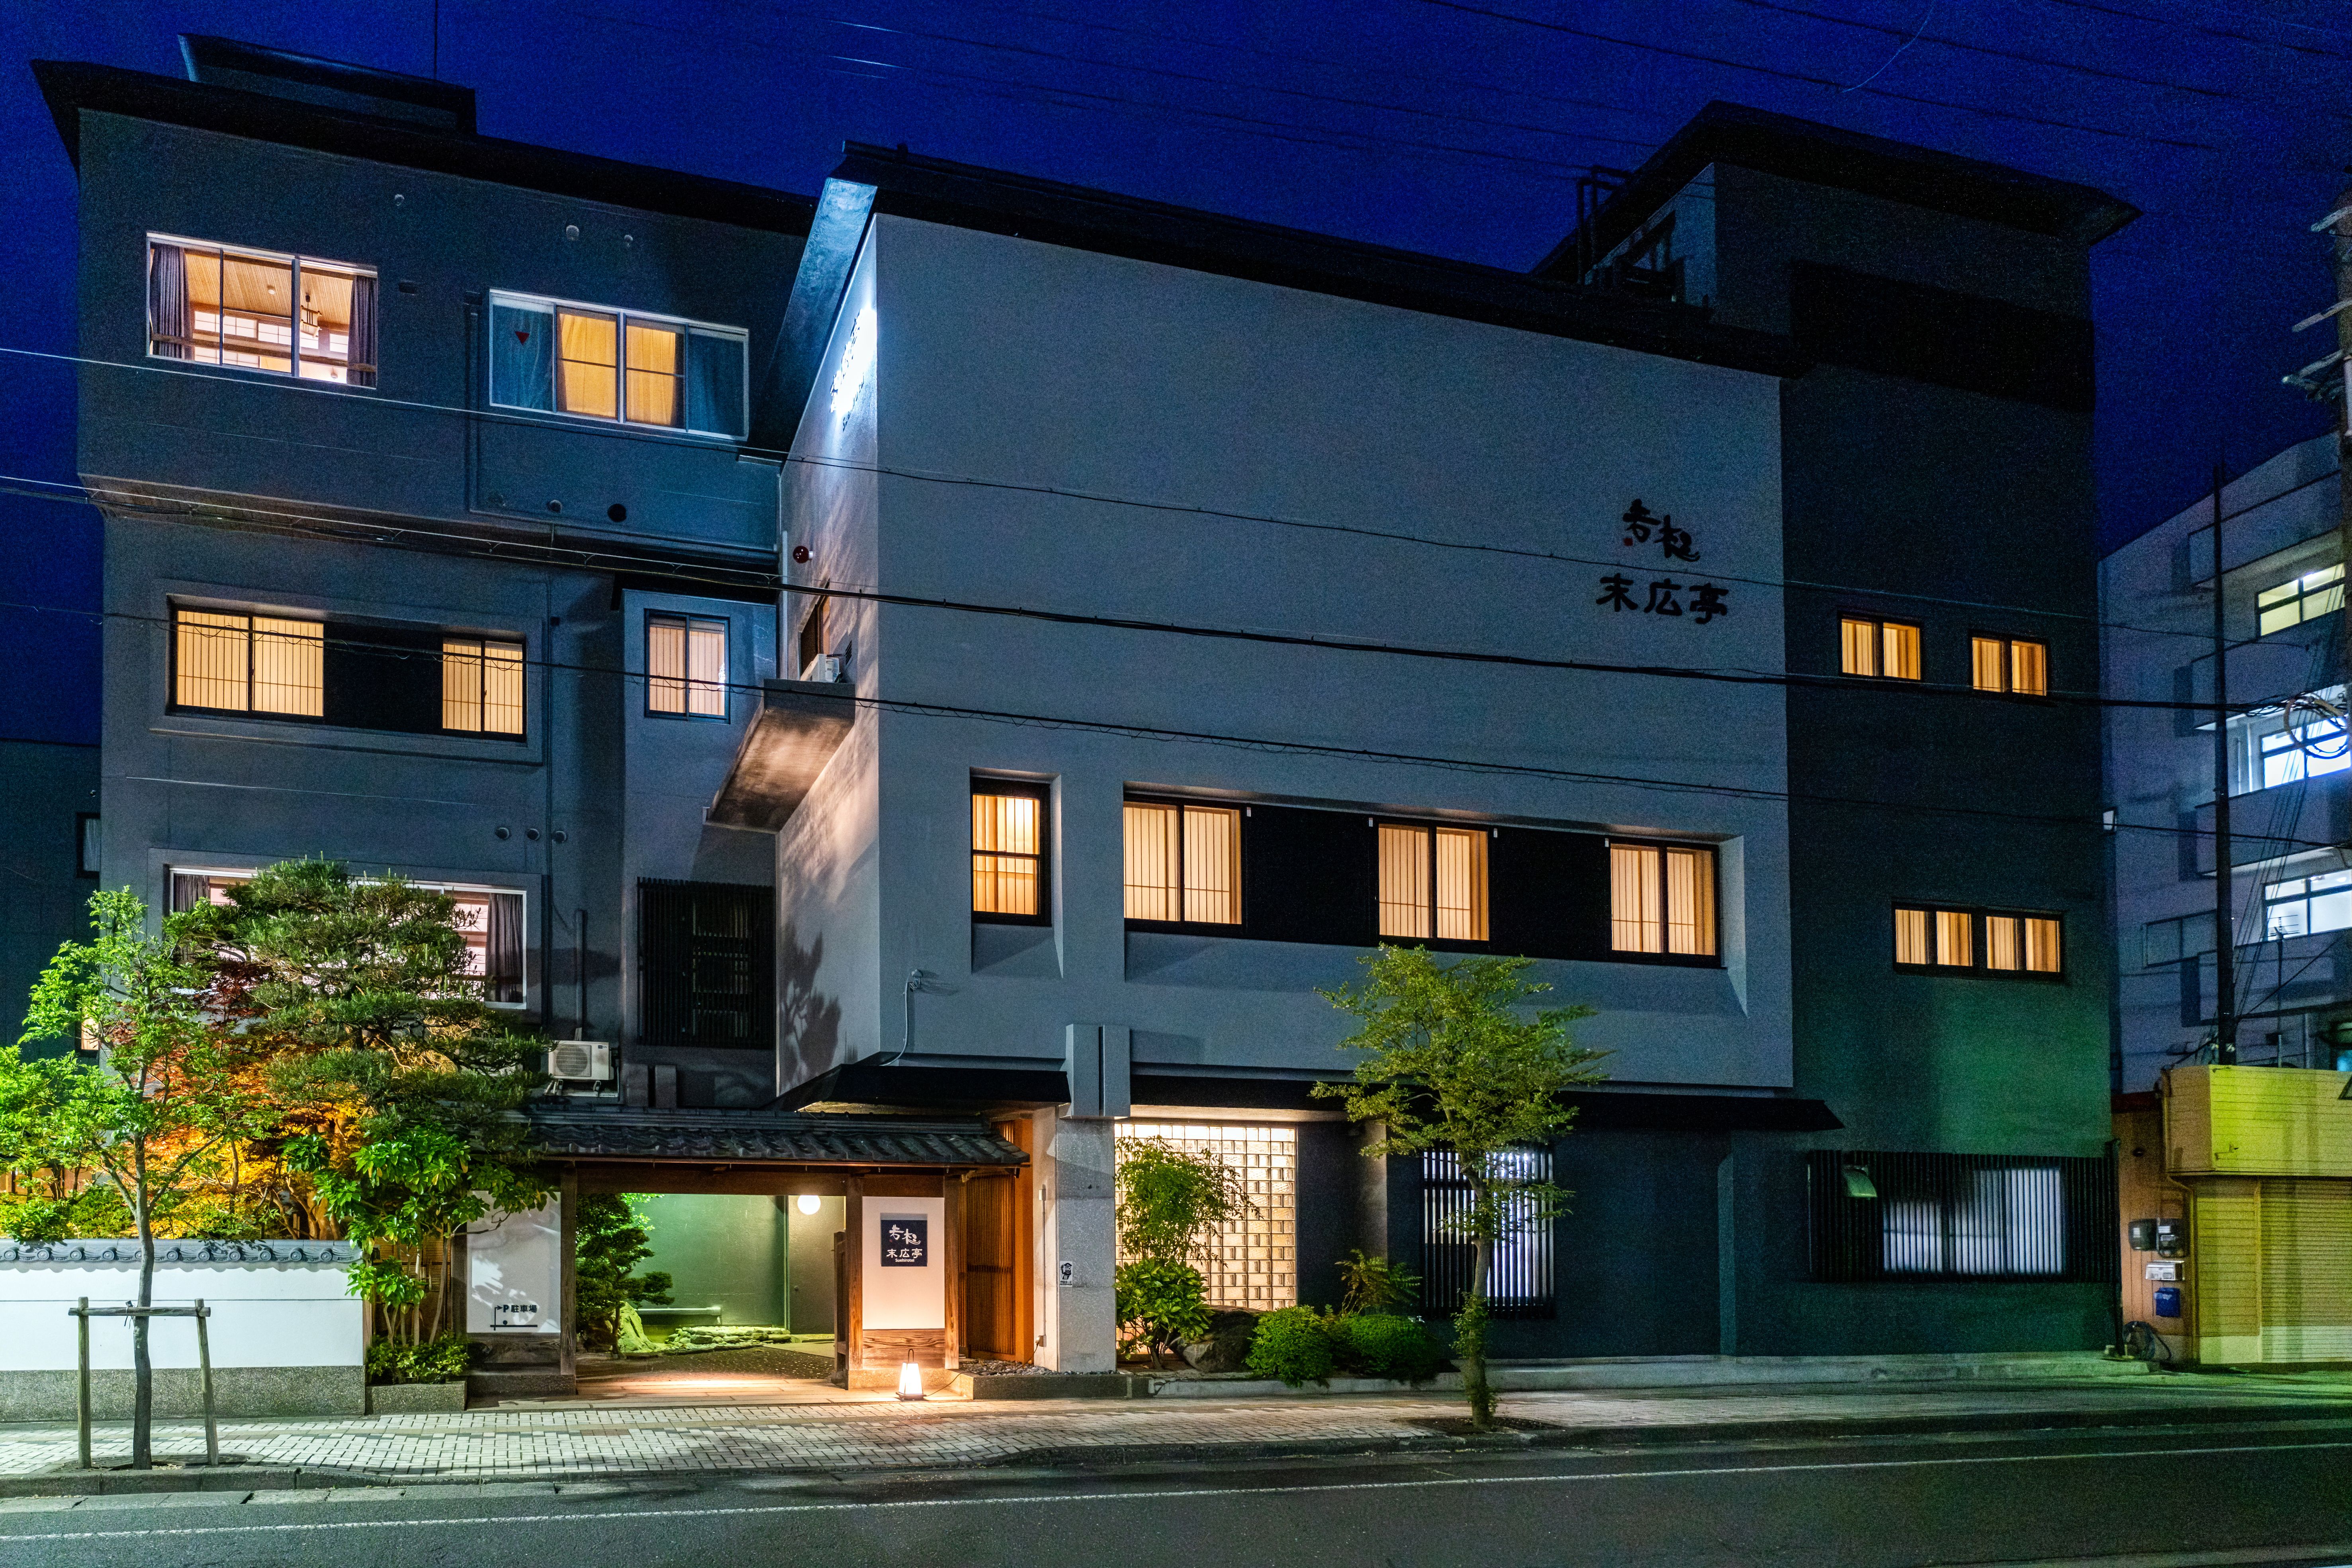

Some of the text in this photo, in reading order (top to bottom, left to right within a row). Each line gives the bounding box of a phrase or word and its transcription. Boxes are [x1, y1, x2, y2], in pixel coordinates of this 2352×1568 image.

[1595, 573, 1729, 624] 末広亭
[886, 1248, 922, 1258] 末広亭
[503, 1304, 537, 1313] P 駐車場
